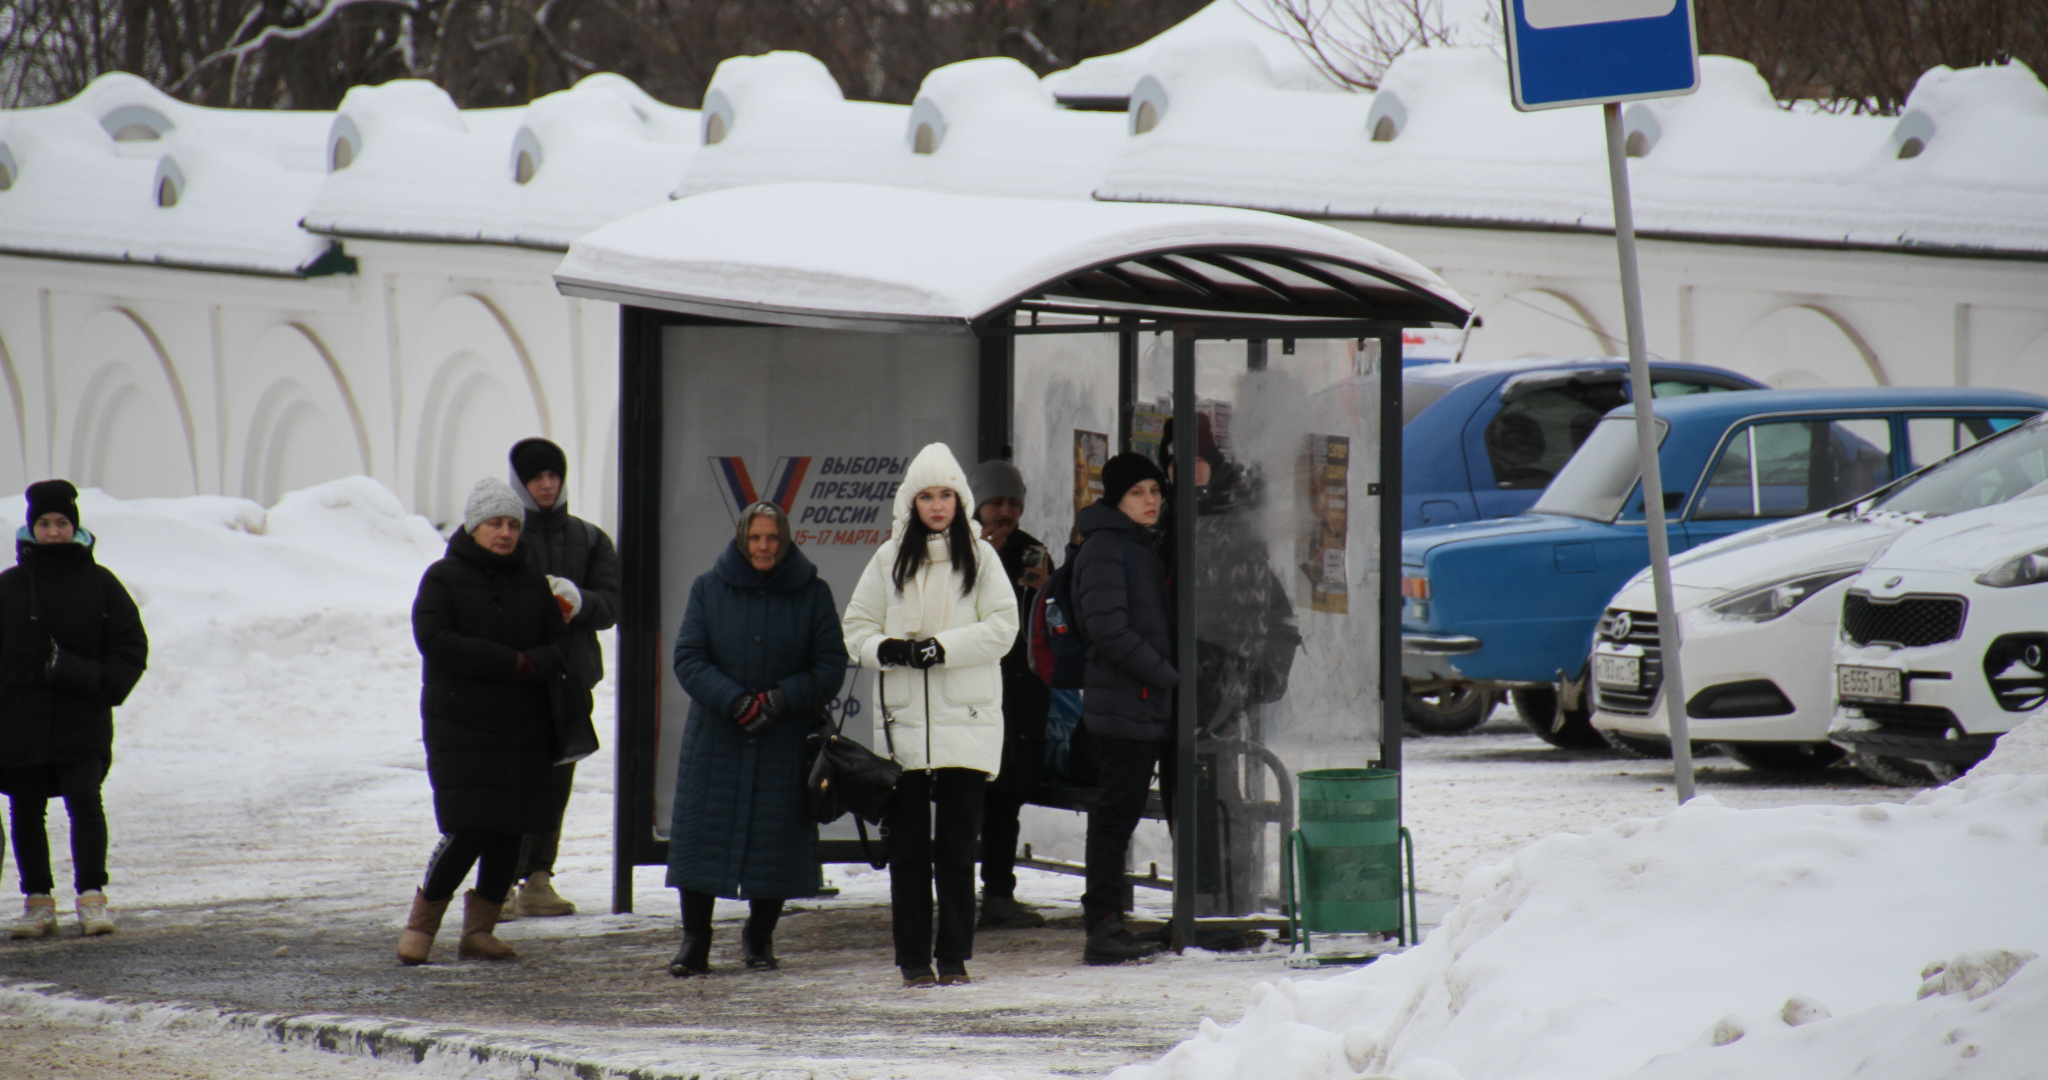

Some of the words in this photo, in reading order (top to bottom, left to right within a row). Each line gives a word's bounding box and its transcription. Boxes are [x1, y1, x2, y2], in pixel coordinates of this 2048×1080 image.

[820, 456, 910, 475] ВЫБОРЫ
[809, 481, 902, 502] ПРЕЗИДЕ
[799, 505, 880, 524] РОССИИ
[831, 529, 880, 546] МАРТА
[1842, 669, 1885, 693] Е555ТА
